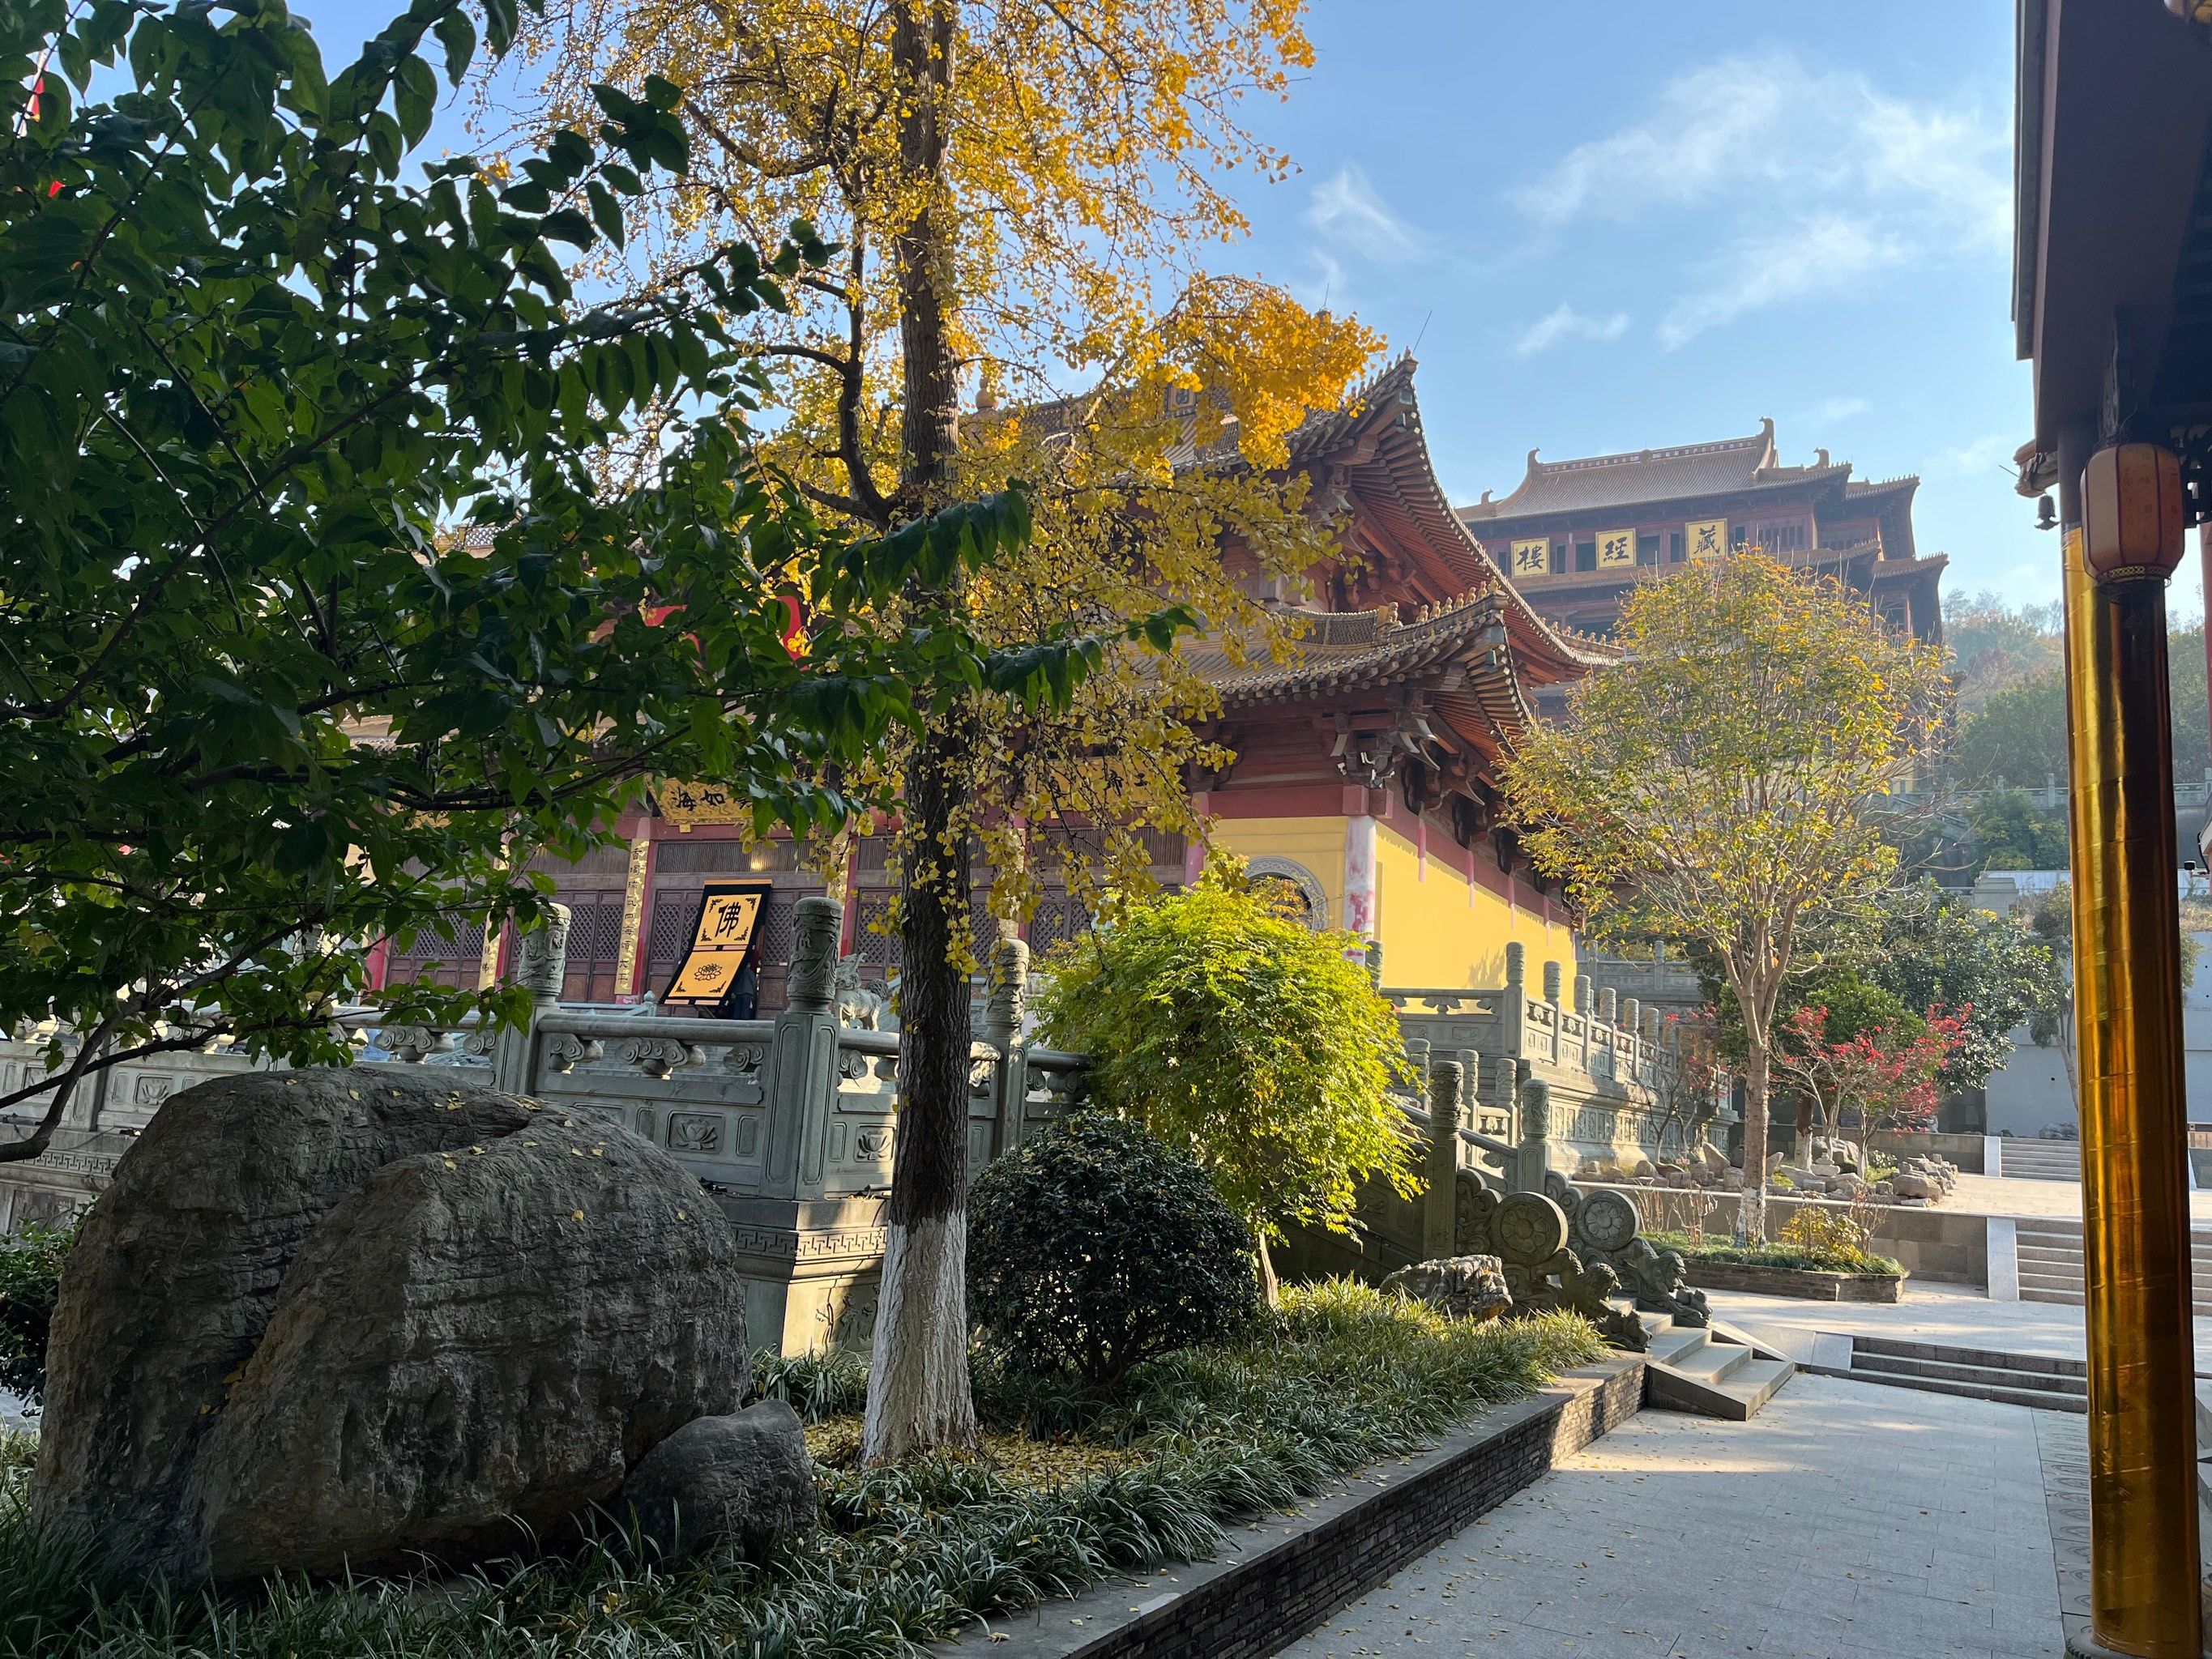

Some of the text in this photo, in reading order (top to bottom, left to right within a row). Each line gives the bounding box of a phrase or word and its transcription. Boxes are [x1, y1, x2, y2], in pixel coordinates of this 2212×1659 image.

[1603, 536, 1629, 561] 經
[1693, 525, 1720, 554] 藏
[1516, 545, 1544, 571] 樓
[715, 902, 741, 937] 佛
